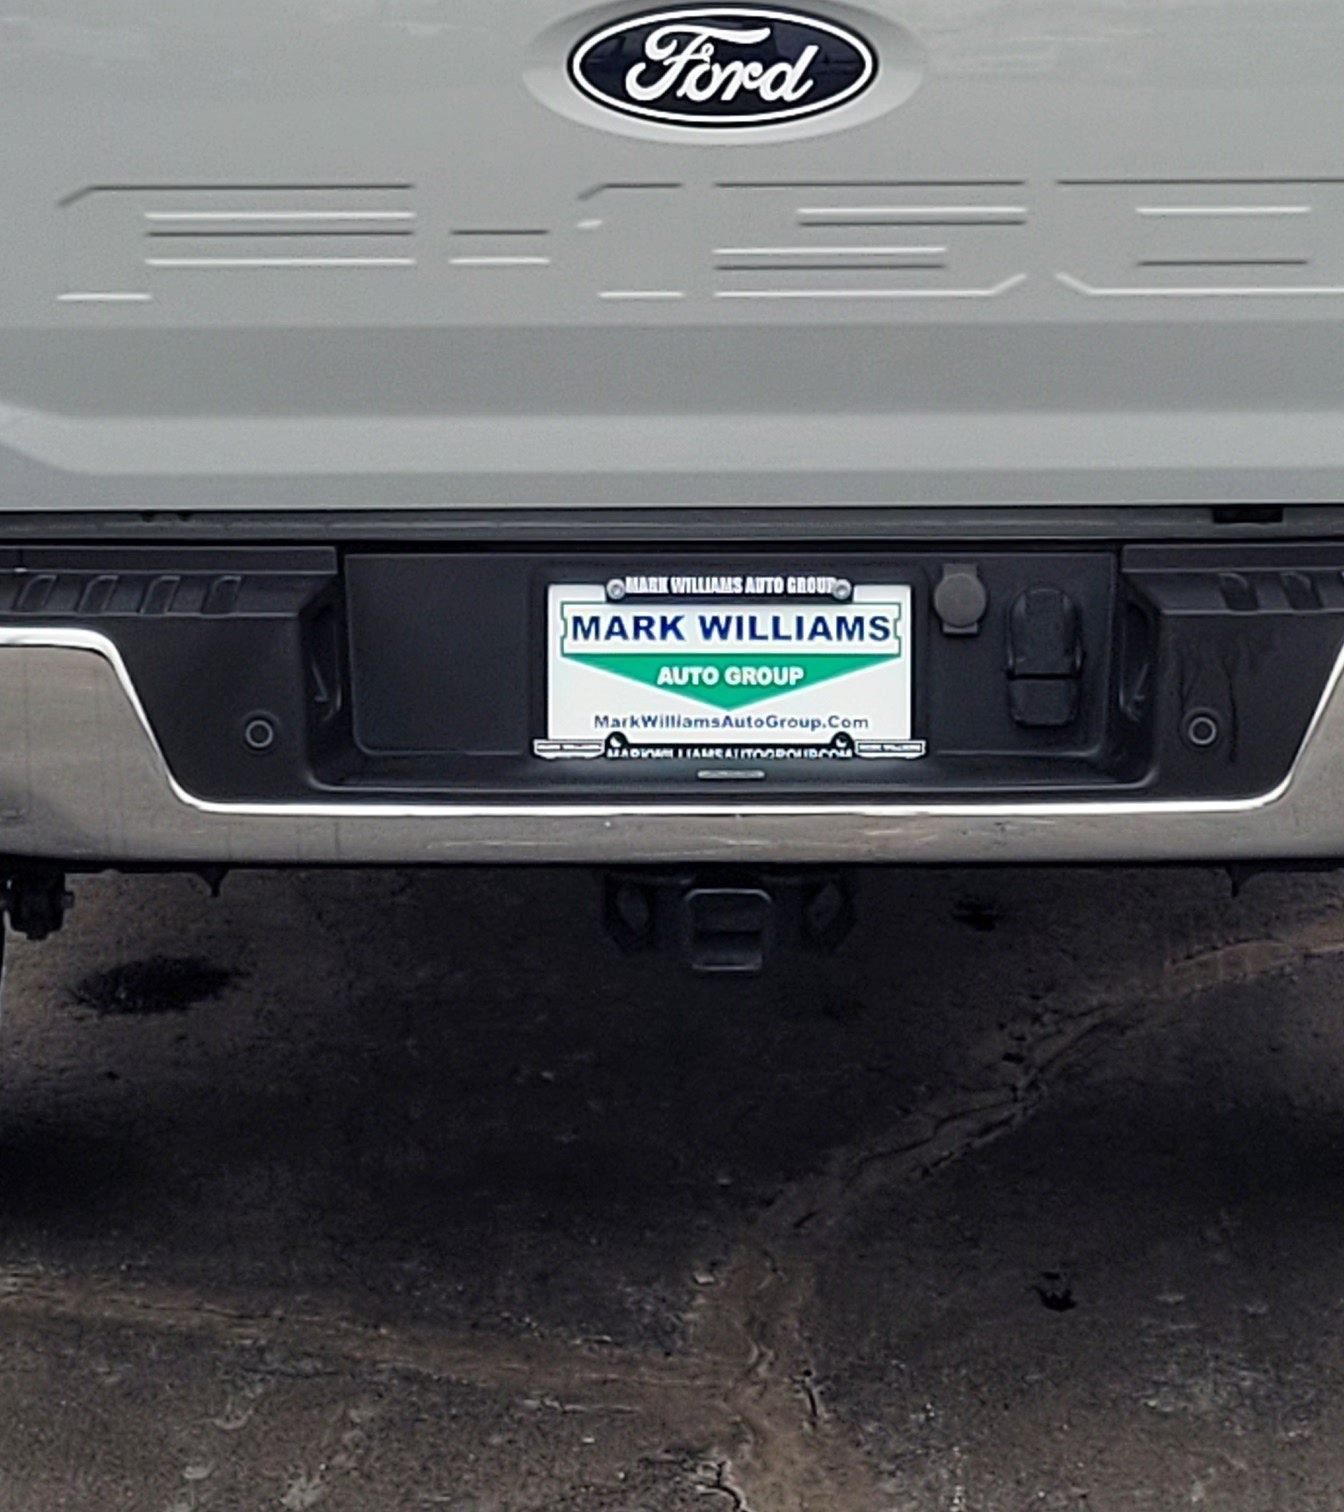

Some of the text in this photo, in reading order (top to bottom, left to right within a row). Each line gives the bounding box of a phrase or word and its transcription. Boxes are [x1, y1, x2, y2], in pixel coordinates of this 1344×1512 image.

[625, 24, 819, 101] Ford
[625, 576, 837, 594] MARK WILLIAMS AUTO GROUP
[571, 615, 891, 641] MARK WILLIAMS
[657, 666, 804, 686] AUTO GROUP
[594, 714, 869, 731] MarkWilliamsAutoGroup.Com
